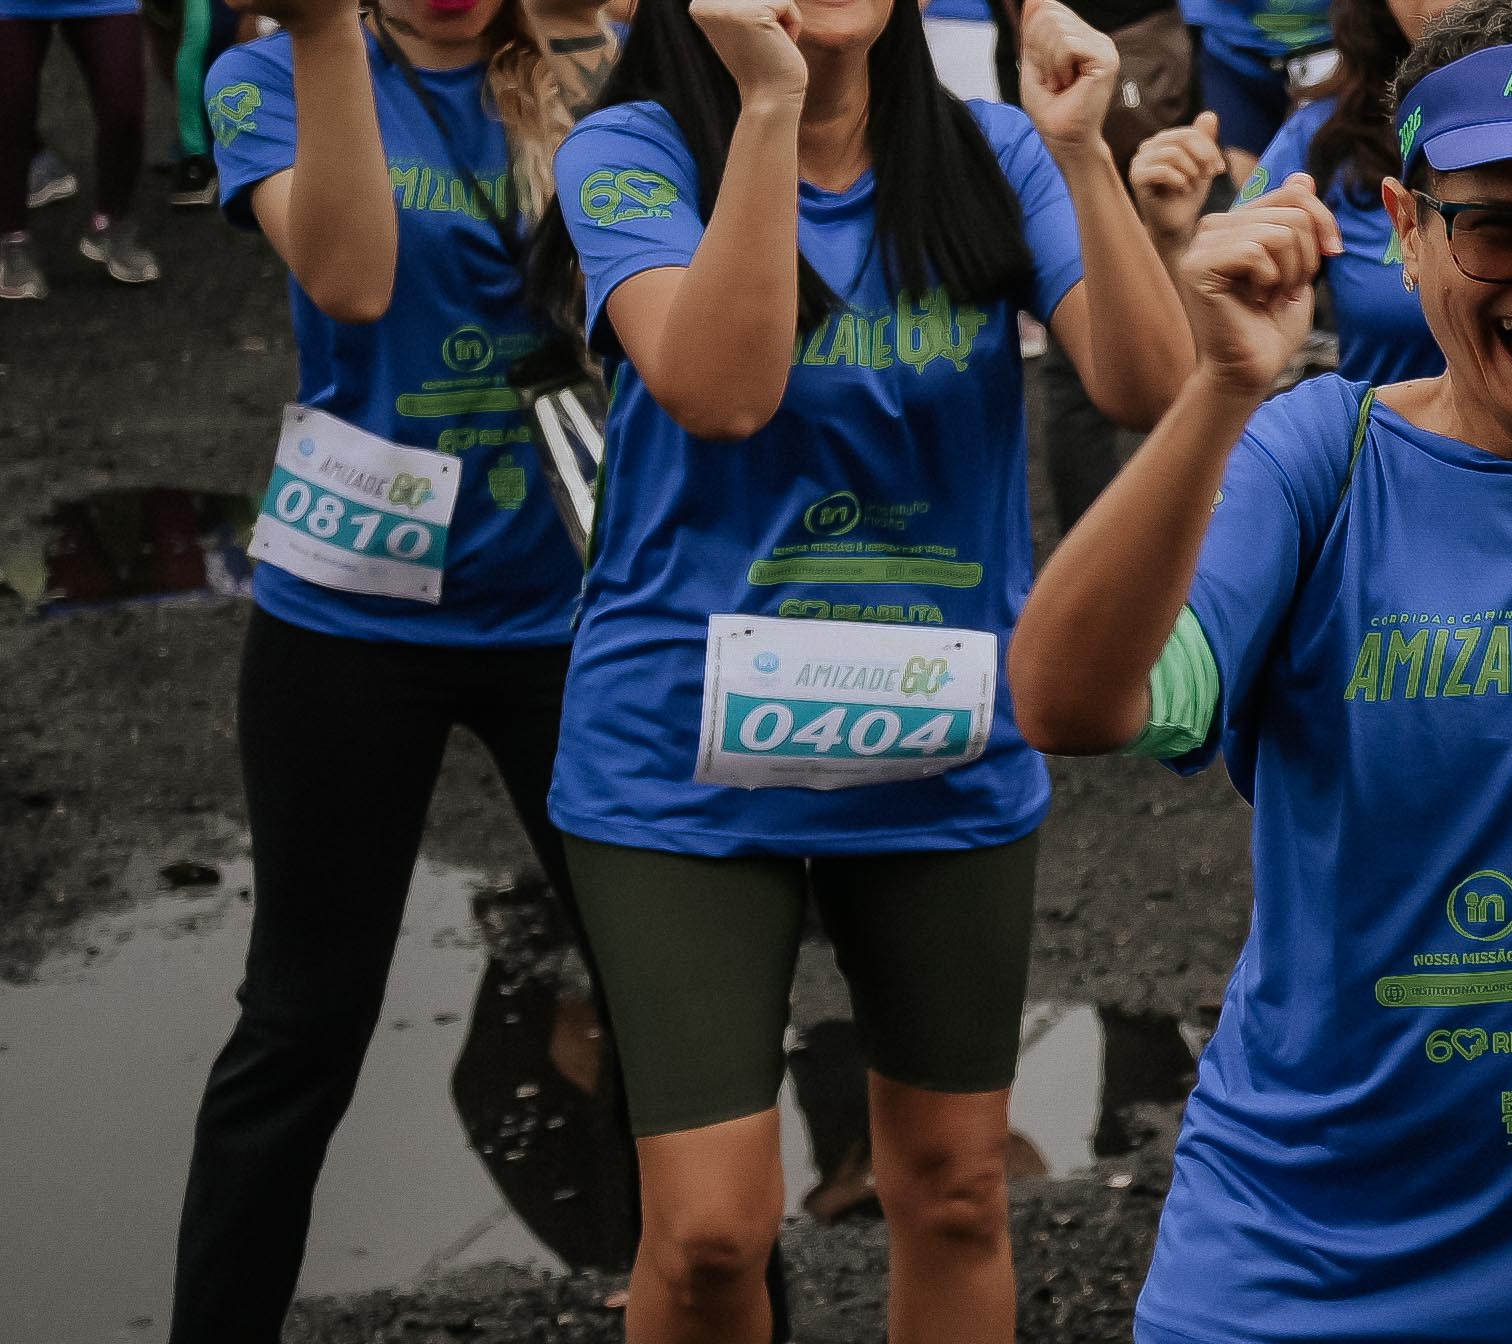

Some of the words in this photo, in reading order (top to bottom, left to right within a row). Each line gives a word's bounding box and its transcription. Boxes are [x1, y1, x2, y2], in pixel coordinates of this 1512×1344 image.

[275, 481, 434, 561] 0810
[1370, 613, 1442, 627] CORRIDA
[796, 663, 901, 692] AMIZADE
[739, 702, 955, 758] 0404
[1413, 952, 1459, 967] NOSSA
